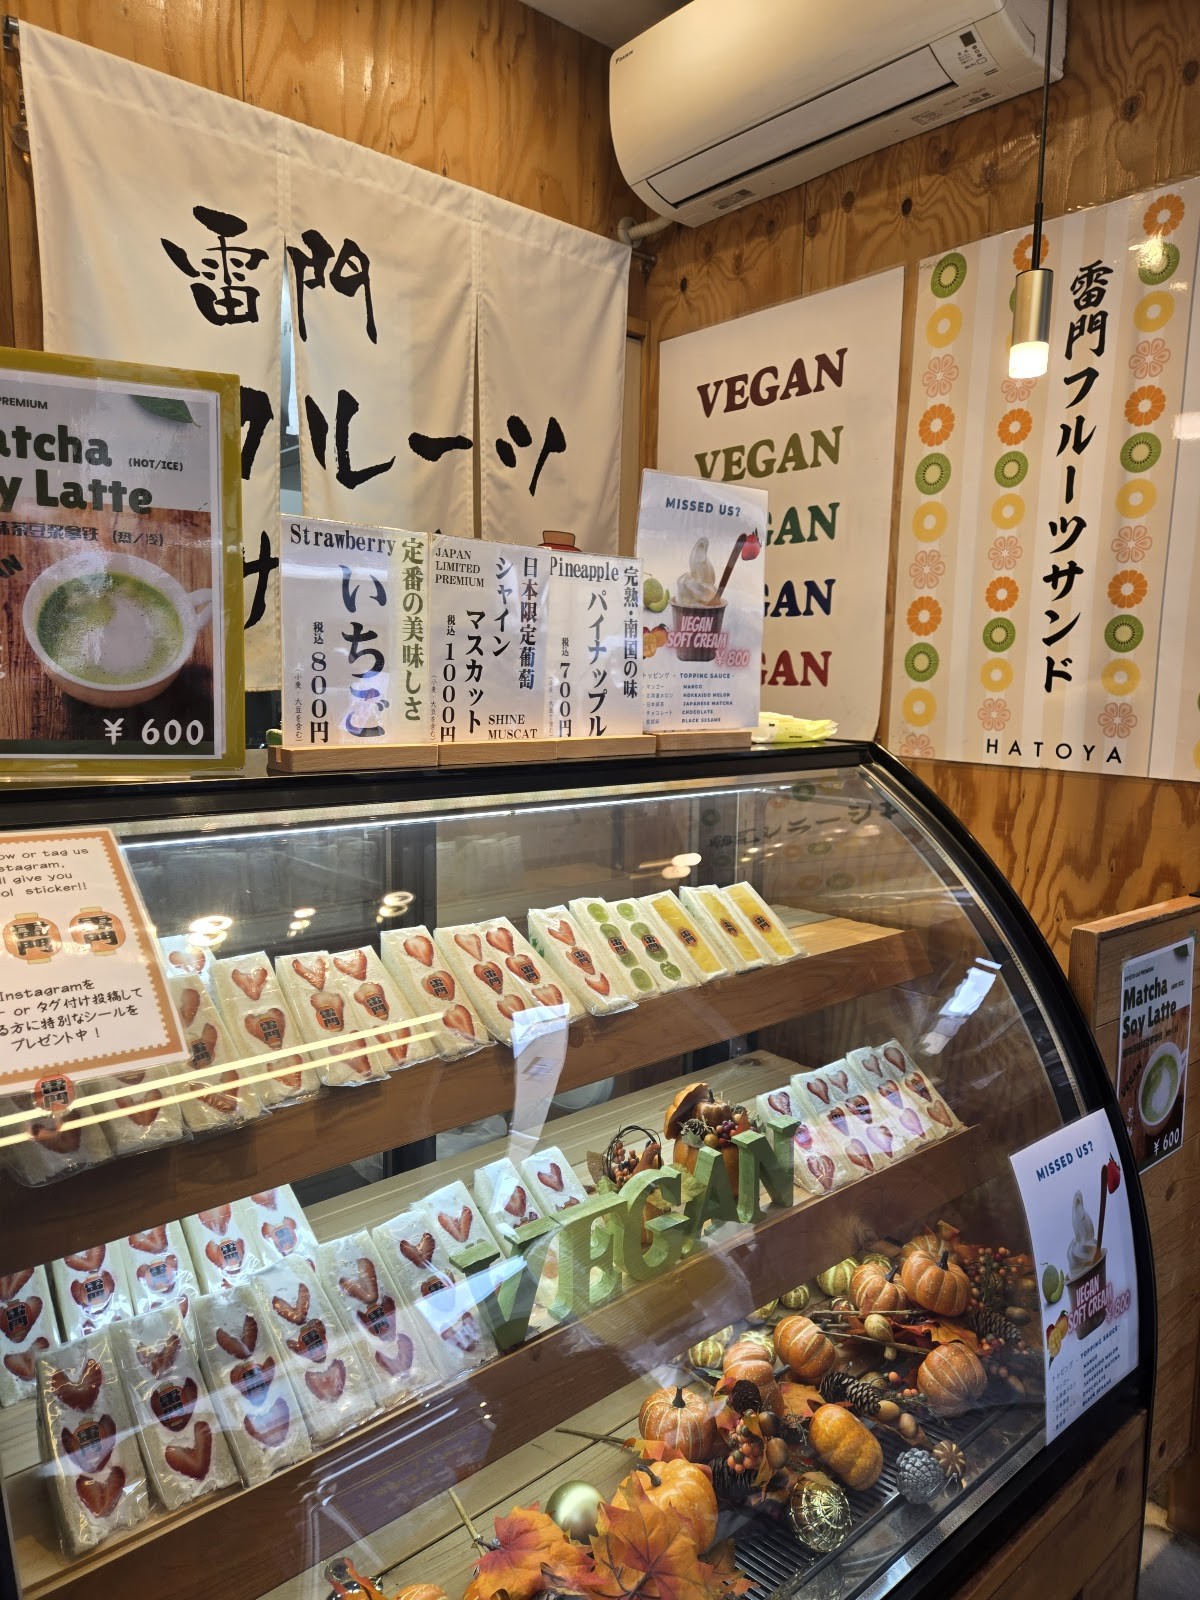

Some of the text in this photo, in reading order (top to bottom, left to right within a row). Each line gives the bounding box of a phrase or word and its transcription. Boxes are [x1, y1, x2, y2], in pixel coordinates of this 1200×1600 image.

[160, 205, 377, 344] 雷門
[697, 347, 848, 418] VEGAN
[128, 457, 184, 472] (HOT/ICE)
[695, 425, 844, 482] VEGAN
[35, 468, 154, 514] Latte
[1042, 259, 1115, 694] 雷門フルーツサンド
[665, 497, 741, 517] MISSED US?
[765, 502, 840, 546] AN
[290, 523, 396, 556] Strawberry
[435, 548, 471, 560] JAPAN
[435, 561, 481, 574] LIMITED
[435, 574, 485, 588] PREMIUM
[550, 556, 619, 582] Pineapple
[492, 556, 514, 657] シャイン
[764, 579, 836, 617] AN
[401, 537, 424, 721] 定番の美味しさ
[518, 556, 539, 690] 日本限定葡萄
[623, 566, 639, 698] 完熟・南国の味
[666, 632, 728, 648] SOFT CREAM
[681, 615, 714, 632] VEGAN
[339, 564, 390, 738] いちご
[588, 590, 608, 736] パイナップル
[761, 649, 832, 687] AN
[465, 609, 486, 734] マスカット
[141, 718, 204, 747] 600
[488, 714, 526, 726] SHINE
[488, 728, 538, 740] MUSCAT
[985, 738, 1123, 765] HATOYA
[13, 875, 42, 884] give
[47, 873, 73, 882] you
[25, 881, 88, 895] sticker!!
[14, 988, 143, 1016] or タグ付け投稿して
[1123, 977, 1168, 1012] Matcha
[0, 1005, 139, 1037] る方に特別なシールを
[1122, 1014, 1145, 1039] Soy
[1148, 1000, 1177, 1028] Latte
[1121, 1060, 1142, 1097] VEGAN
[1162, 1128, 1180, 1151] 600
[1036, 1140, 1093, 1181] MISSED US?
[1067, 1283, 1113, 1333] SOFT CREAM
[1076, 1274, 1100, 1307] VEGAN
